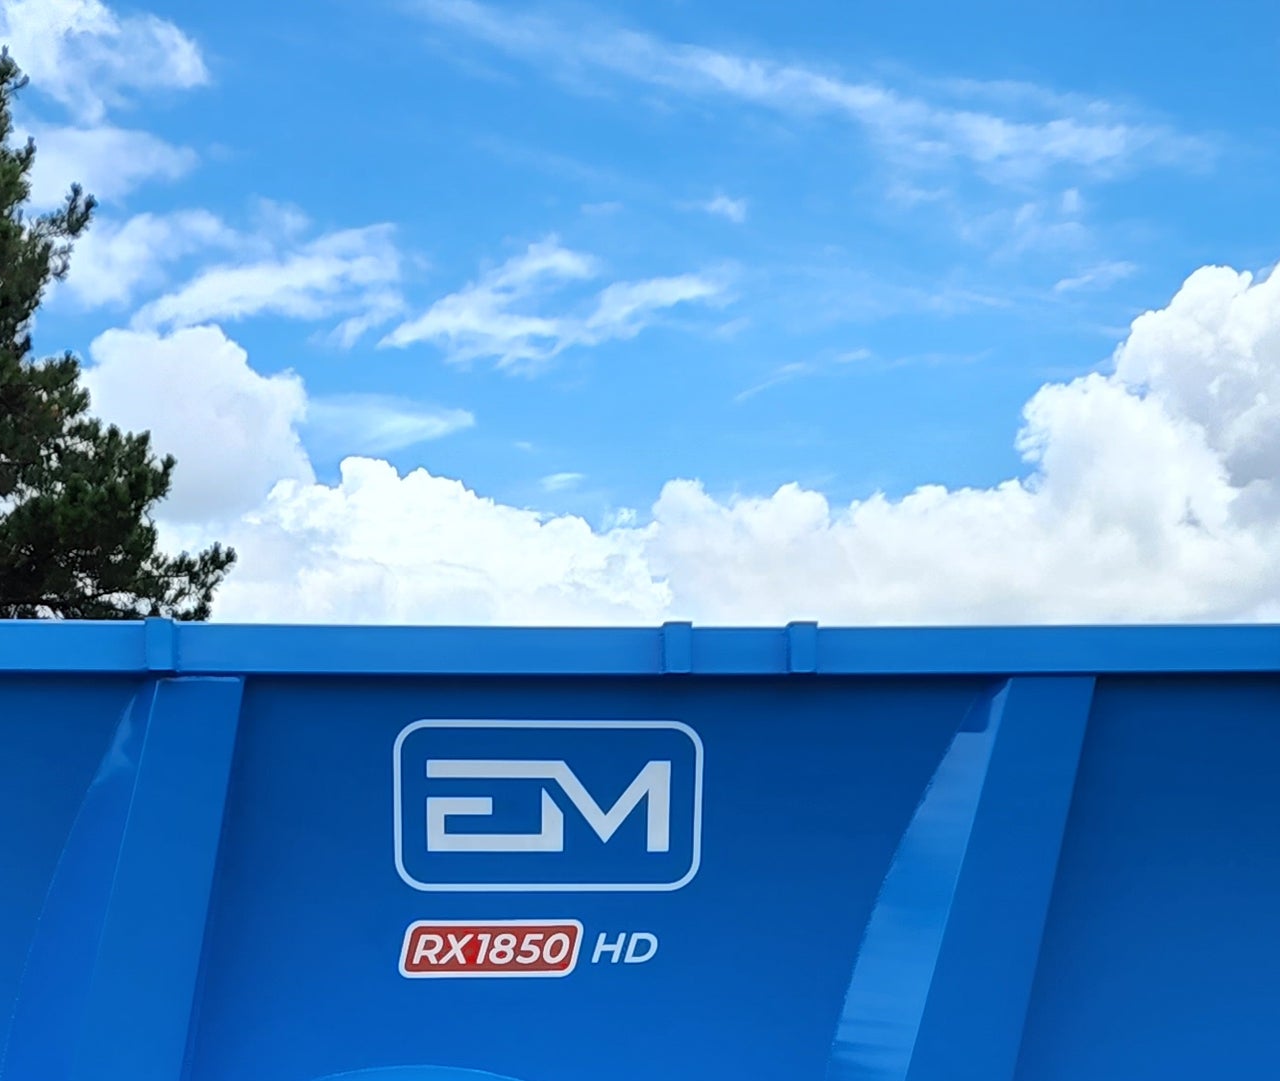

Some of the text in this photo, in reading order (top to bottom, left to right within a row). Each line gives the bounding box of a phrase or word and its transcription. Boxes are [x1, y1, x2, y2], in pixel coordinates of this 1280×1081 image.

[426, 760, 671, 852] EM
[411, 931, 659, 965] RX1850 HD
